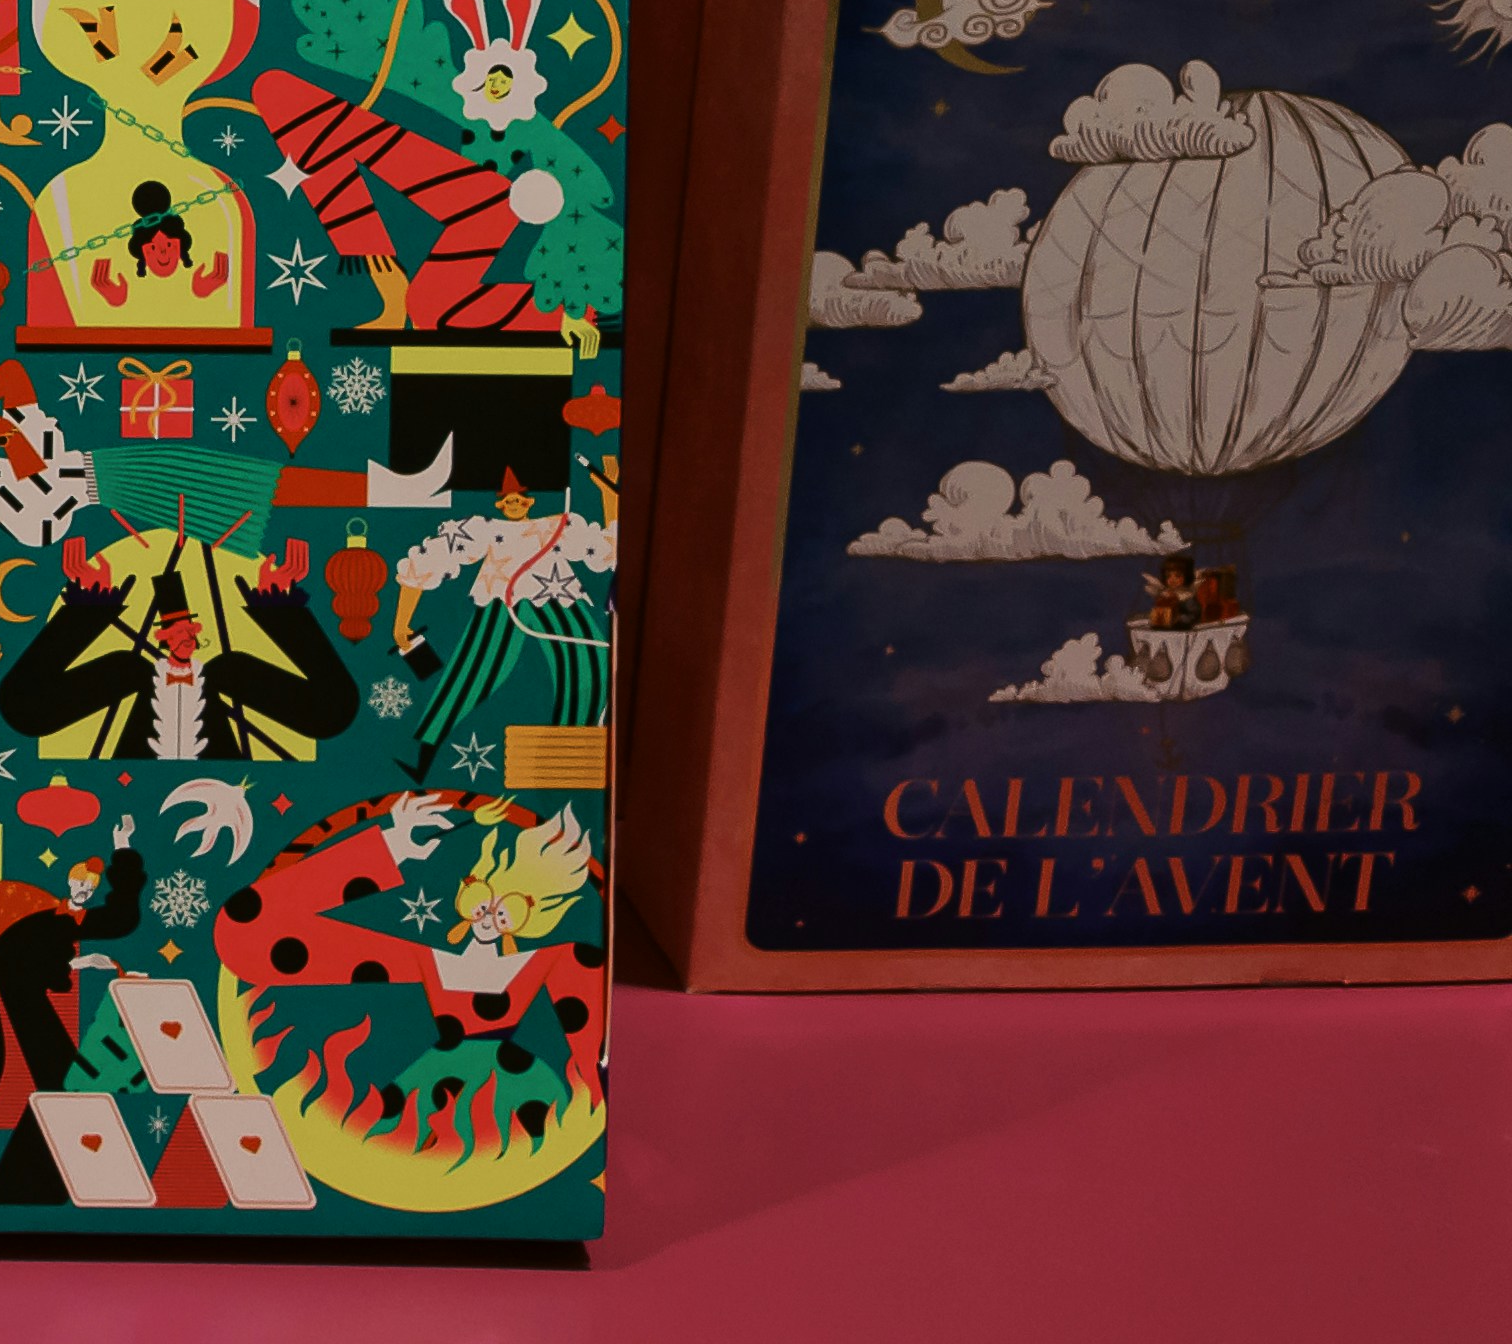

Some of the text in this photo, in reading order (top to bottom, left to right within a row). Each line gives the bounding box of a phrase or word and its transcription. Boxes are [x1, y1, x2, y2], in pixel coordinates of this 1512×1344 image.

[884, 768, 1423, 842] CALENDRIER
[895, 850, 1396, 920] DE L'AVENT
